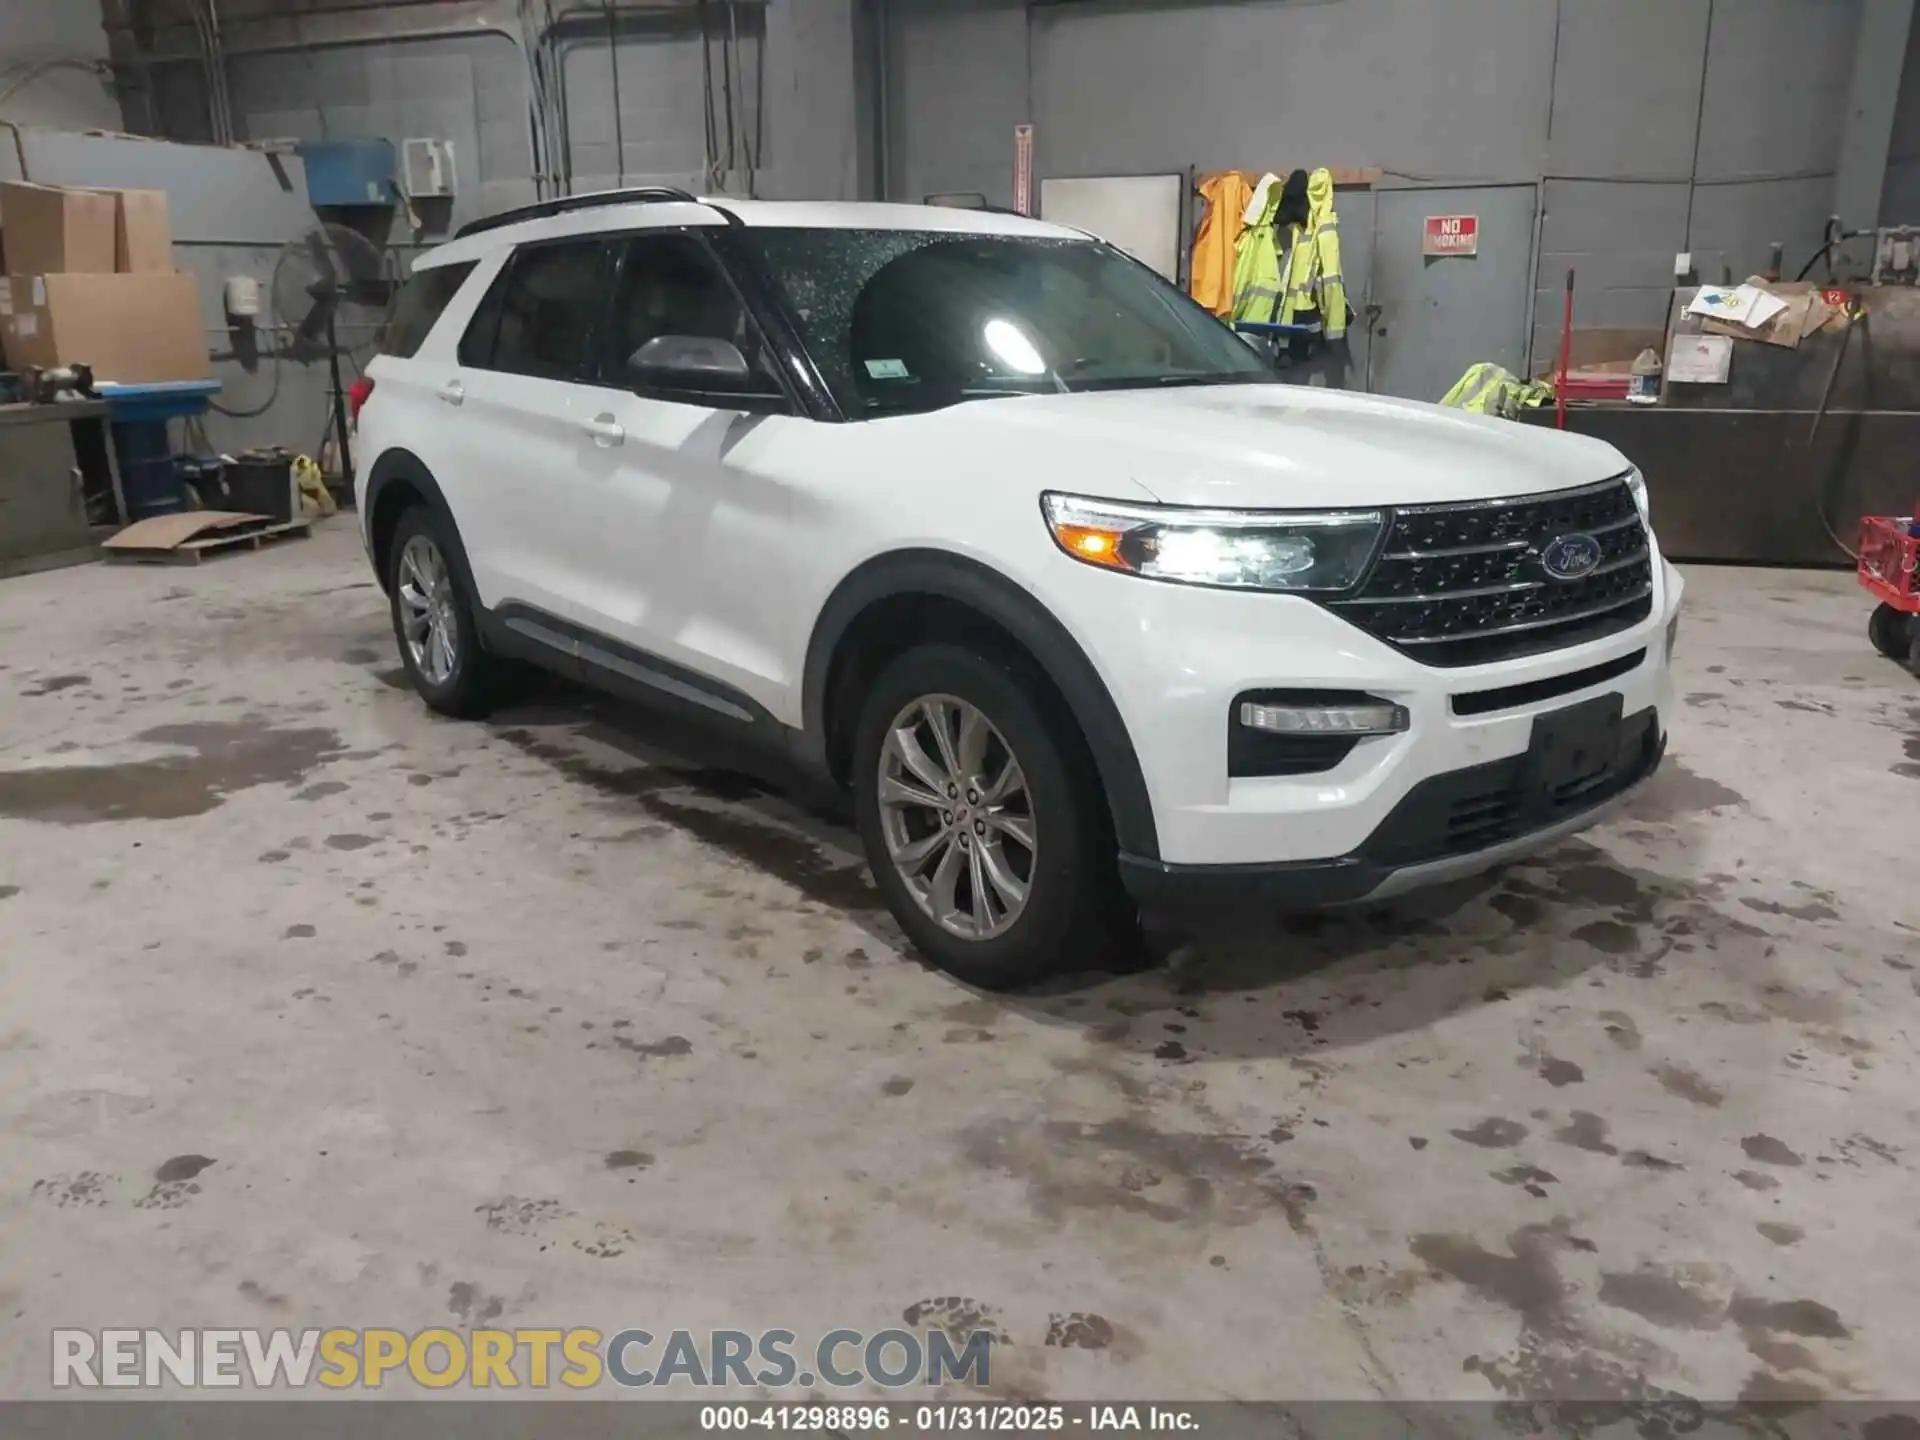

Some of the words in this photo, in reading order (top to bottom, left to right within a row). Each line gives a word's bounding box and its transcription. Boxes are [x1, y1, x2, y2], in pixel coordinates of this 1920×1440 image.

[1441, 219, 1461, 234] NO
[1429, 234, 1475, 248] MOKING
[1560, 544, 1591, 571] Ford
